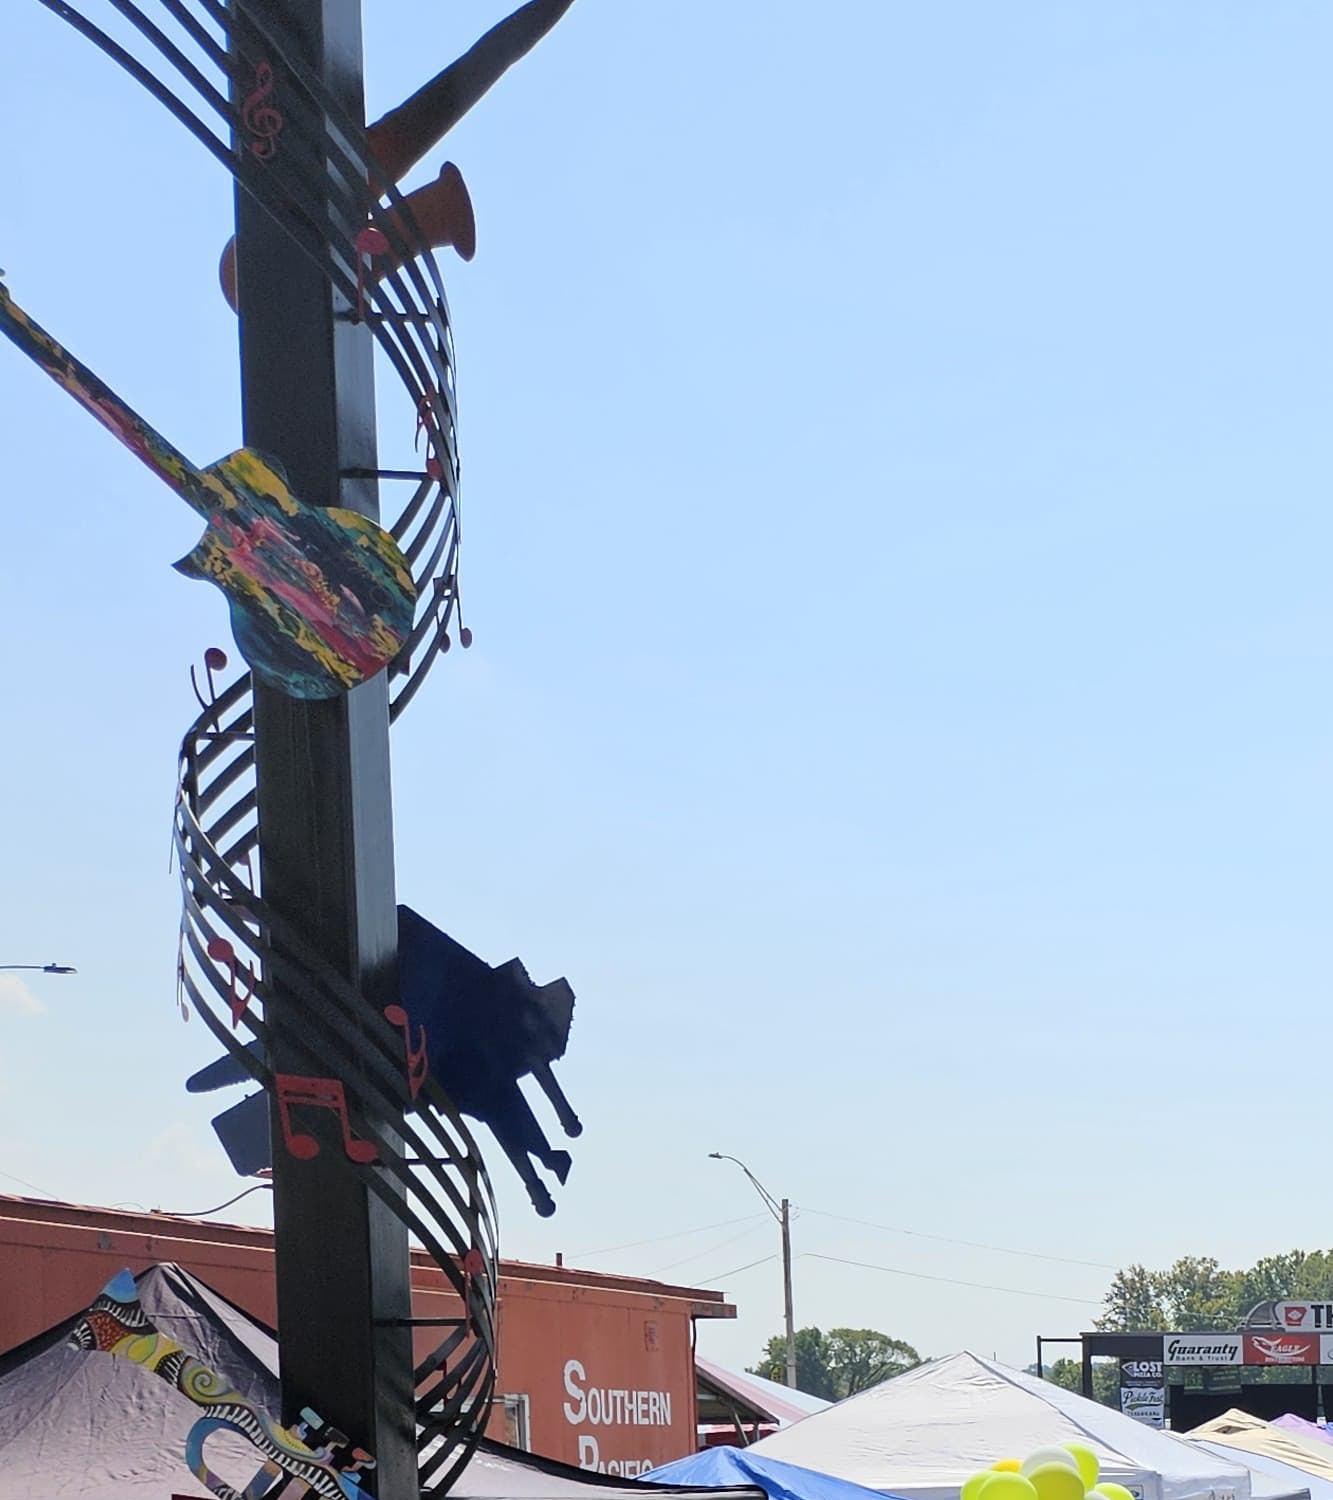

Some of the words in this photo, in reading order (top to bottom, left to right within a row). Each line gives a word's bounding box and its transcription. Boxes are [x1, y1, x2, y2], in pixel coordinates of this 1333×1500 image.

[1168, 1339, 1238, 1360] Guaranty
[1133, 1361, 1163, 1372] LOST
[563, 1360, 672, 1426] SOUTHERN
